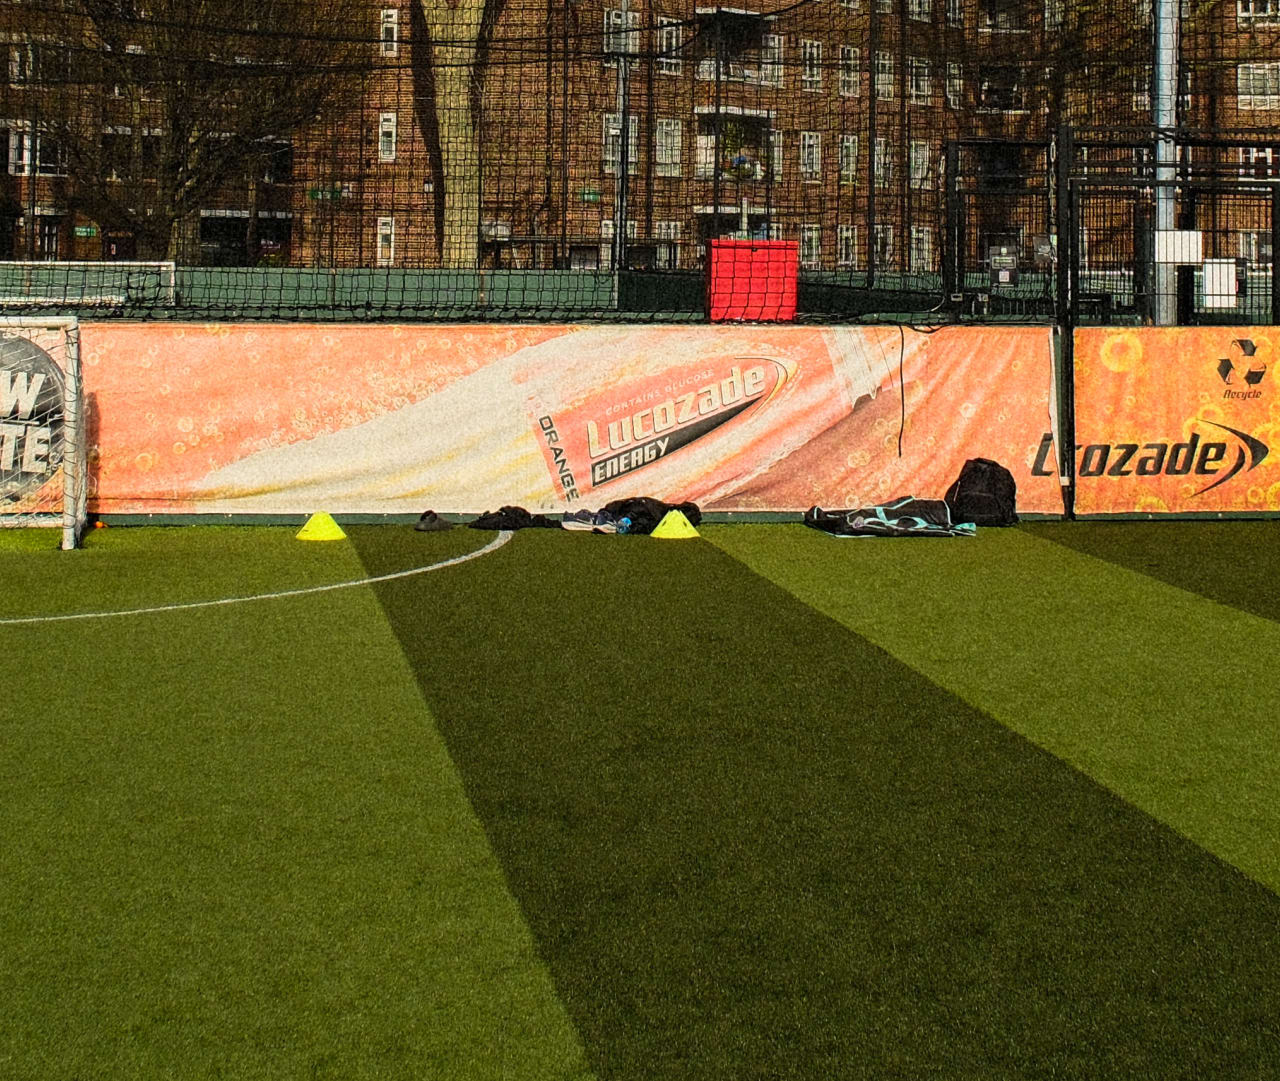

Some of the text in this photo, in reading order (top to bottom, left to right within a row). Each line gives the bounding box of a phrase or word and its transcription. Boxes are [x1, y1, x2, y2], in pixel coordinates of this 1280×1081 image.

[586, 364, 767, 460] Lucozade
[605, 388, 661, 416] CONTAINS
[1223, 389, 1262, 401] Recycle
[538, 415, 580, 503] ORANGE
[594, 436, 670, 483] ENERGY
